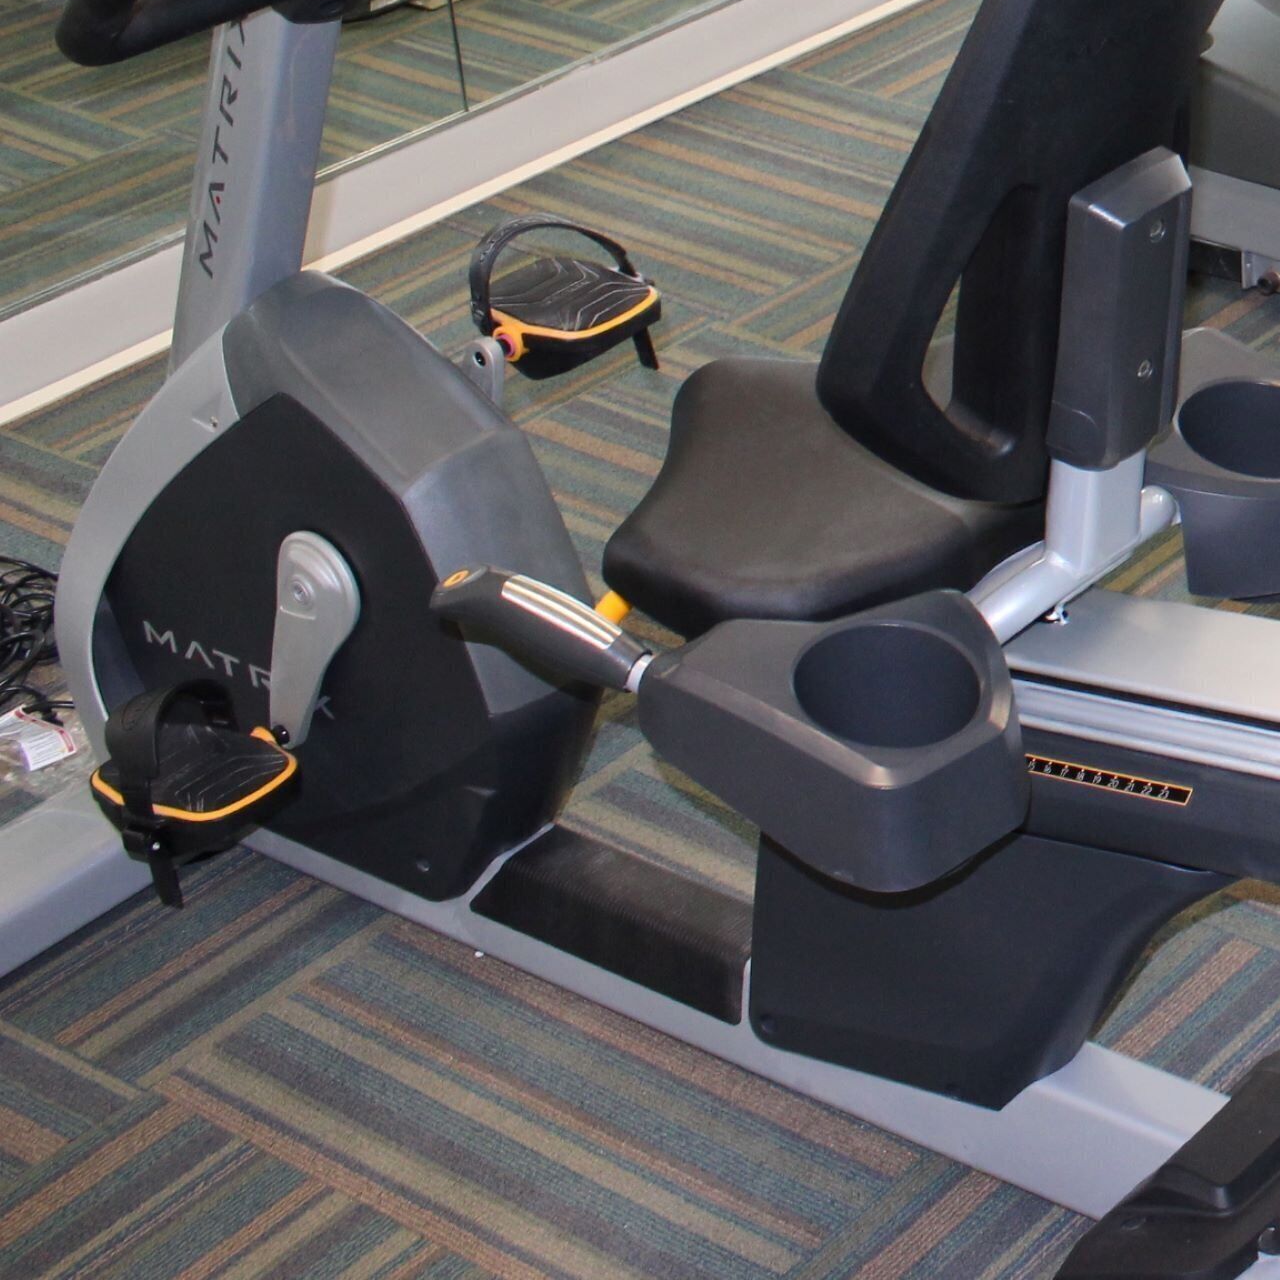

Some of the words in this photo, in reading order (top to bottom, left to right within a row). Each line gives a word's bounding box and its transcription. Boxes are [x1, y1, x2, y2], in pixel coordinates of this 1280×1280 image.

[1108, 778, 1119, 788] 20
[1125, 781, 1135, 791] 21
[1141, 785, 1153, 795] 22
[1158, 789, 1170, 799] 23
